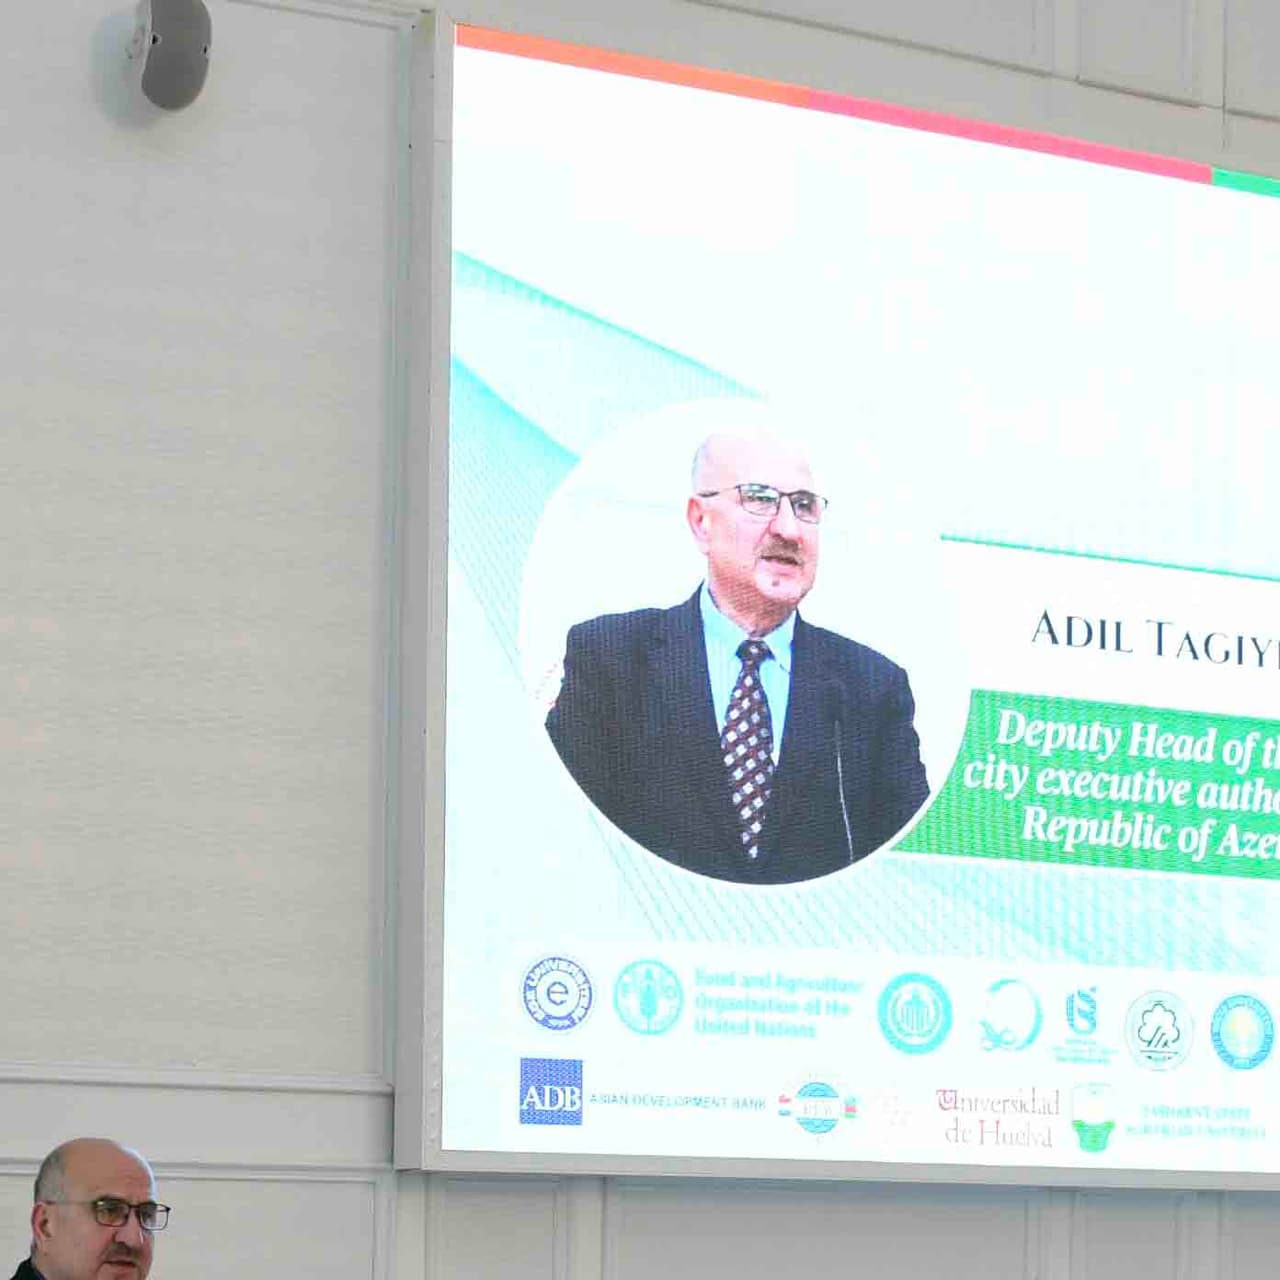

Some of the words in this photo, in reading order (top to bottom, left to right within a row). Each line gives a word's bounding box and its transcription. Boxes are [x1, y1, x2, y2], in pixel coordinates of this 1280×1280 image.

[1031, 608, 1133, 655] ADIL
[997, 709, 1121, 763] Deputy
[1128, 720, 1215, 764] Head
[1222, 730, 1258, 774] of
[962, 755, 1031, 801] city
[1036, 762, 1191, 807] executive
[1021, 805, 1173, 854] Republic
[1178, 814, 1216, 863] of
[520, 1085, 582, 1112] ADB
